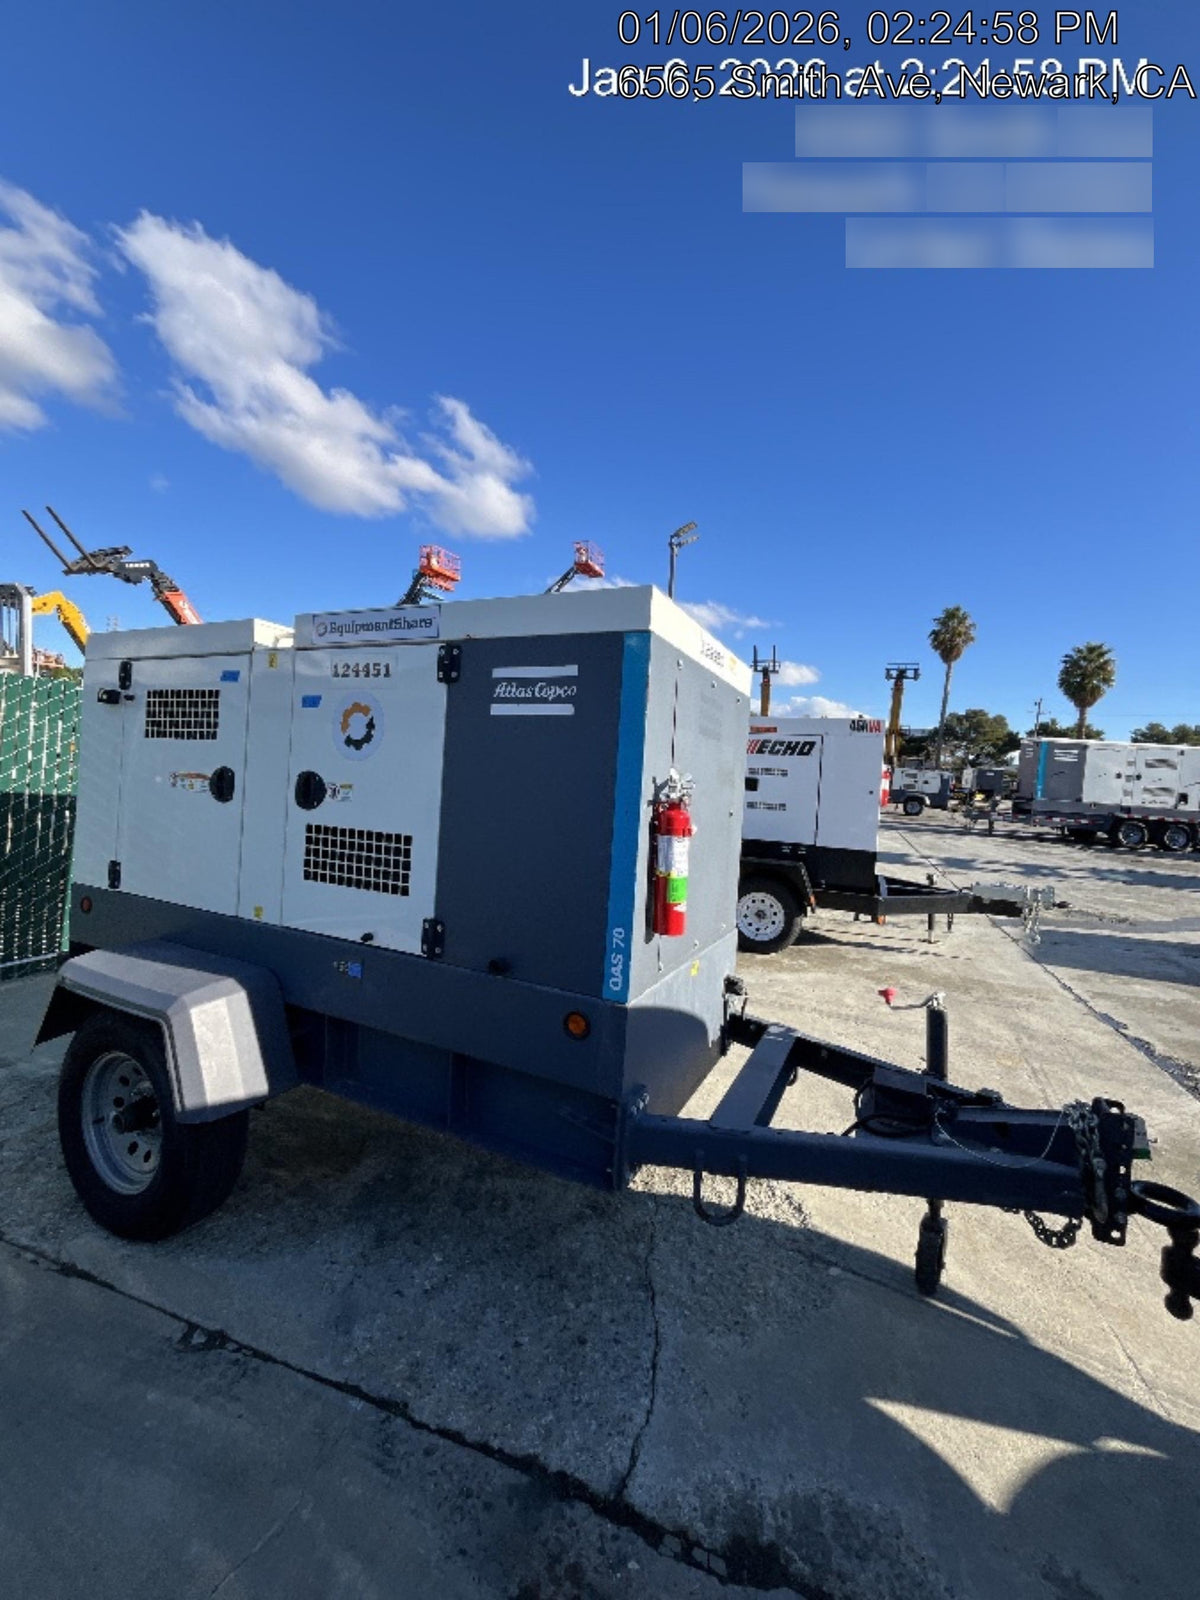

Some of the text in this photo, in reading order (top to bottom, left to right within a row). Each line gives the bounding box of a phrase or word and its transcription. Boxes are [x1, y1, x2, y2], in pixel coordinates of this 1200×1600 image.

[331, 663, 392, 678] 124451
[493, 682, 533, 698] Atlas
[756, 741, 817, 756] ECHO
[613, 927, 625, 948] 70
